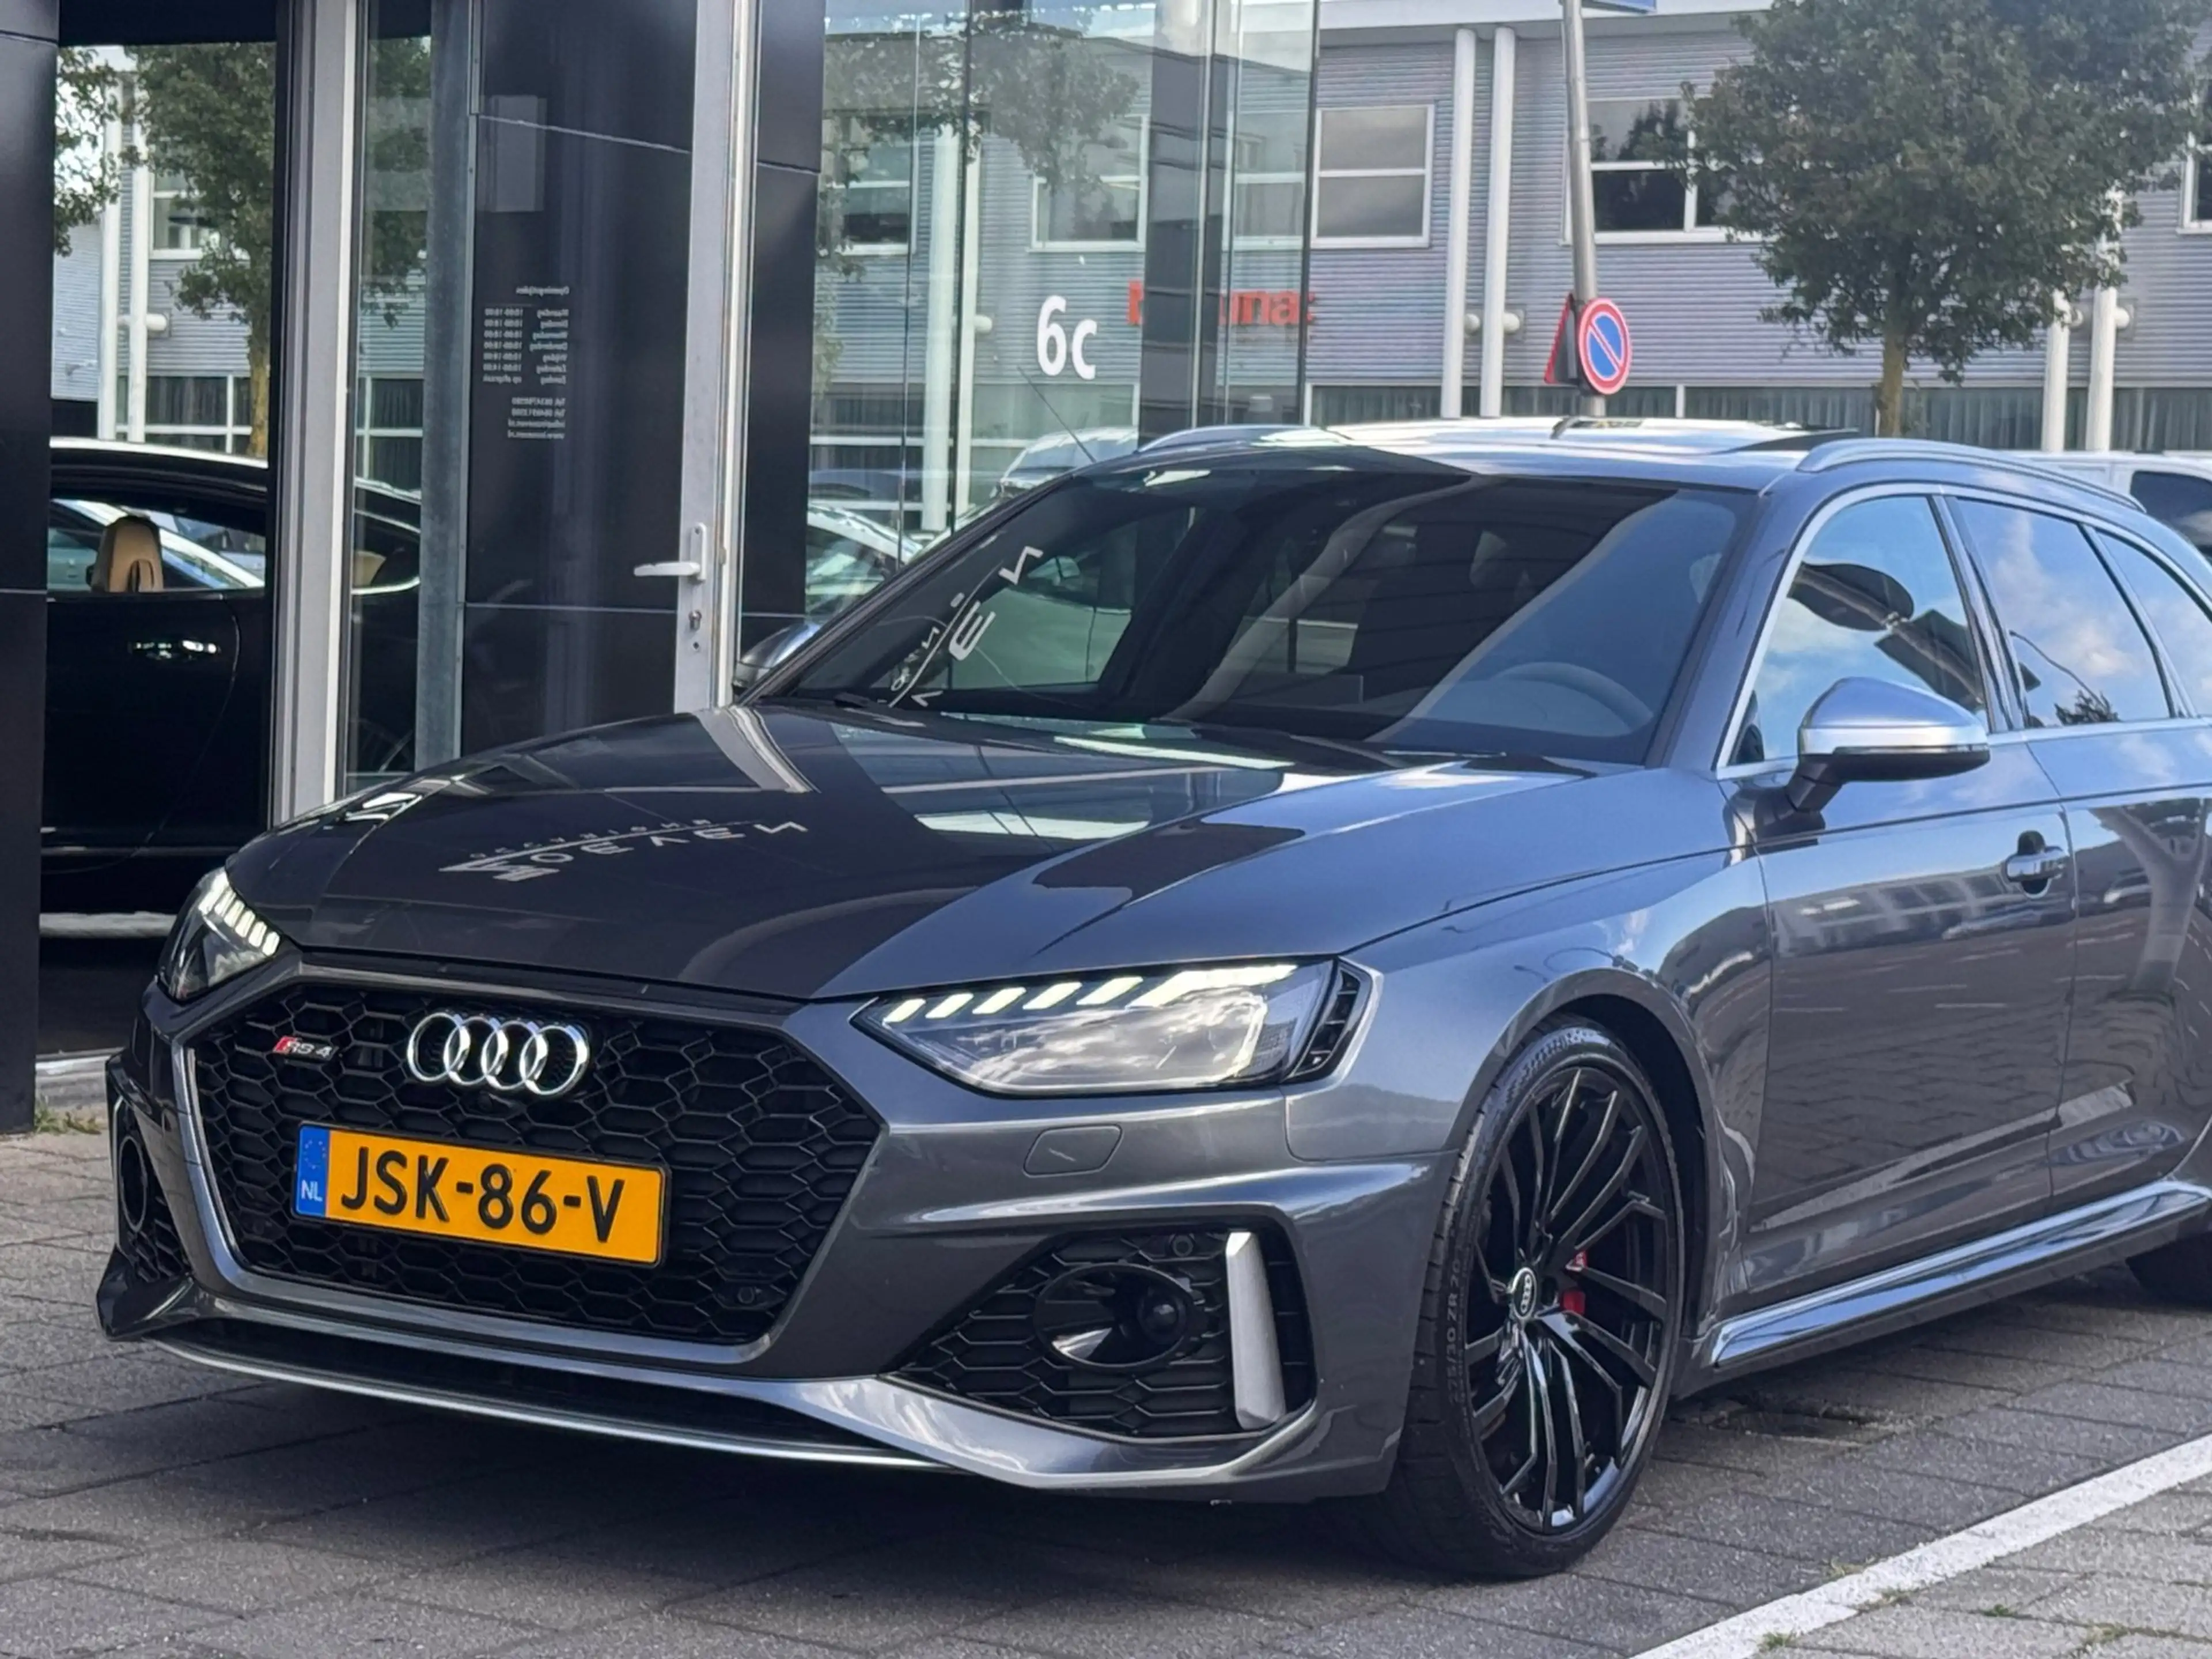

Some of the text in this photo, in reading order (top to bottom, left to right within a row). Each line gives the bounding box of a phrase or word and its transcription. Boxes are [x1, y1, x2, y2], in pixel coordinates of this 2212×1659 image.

[1037, 295, 1097, 380] 6c
[300, 1179, 323, 1202] NL
[341, 1146, 625, 1243] JSK-86-V
